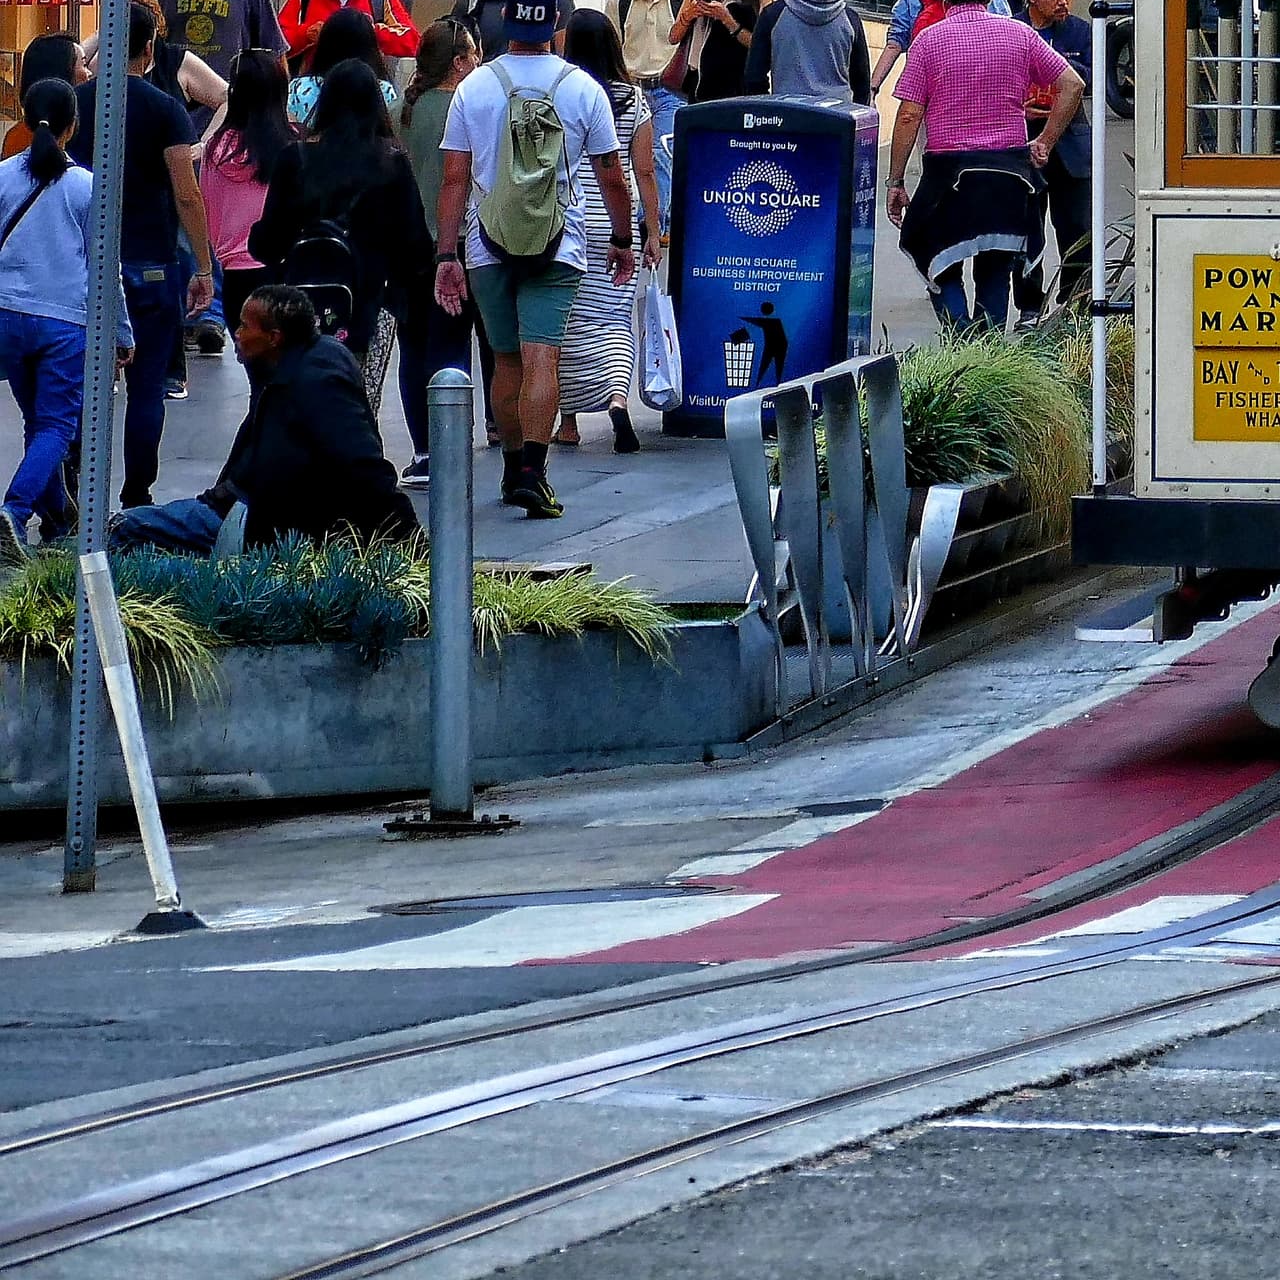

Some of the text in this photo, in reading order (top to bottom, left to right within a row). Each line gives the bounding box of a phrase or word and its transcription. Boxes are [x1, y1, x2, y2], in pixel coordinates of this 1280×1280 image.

[516, 3, 545, 21] MO
[730, 139, 797, 152] Brought to you by
[704, 191, 820, 208] UNION SQUARE
[717, 256, 797, 269] UNION SQUARE
[693, 268, 824, 282] BUSINESS IMPROVEMENT
[734, 282, 781, 292] DISTRICT
[1203, 361, 1239, 385] BAY
[1248, 361, 1271, 385] AND
